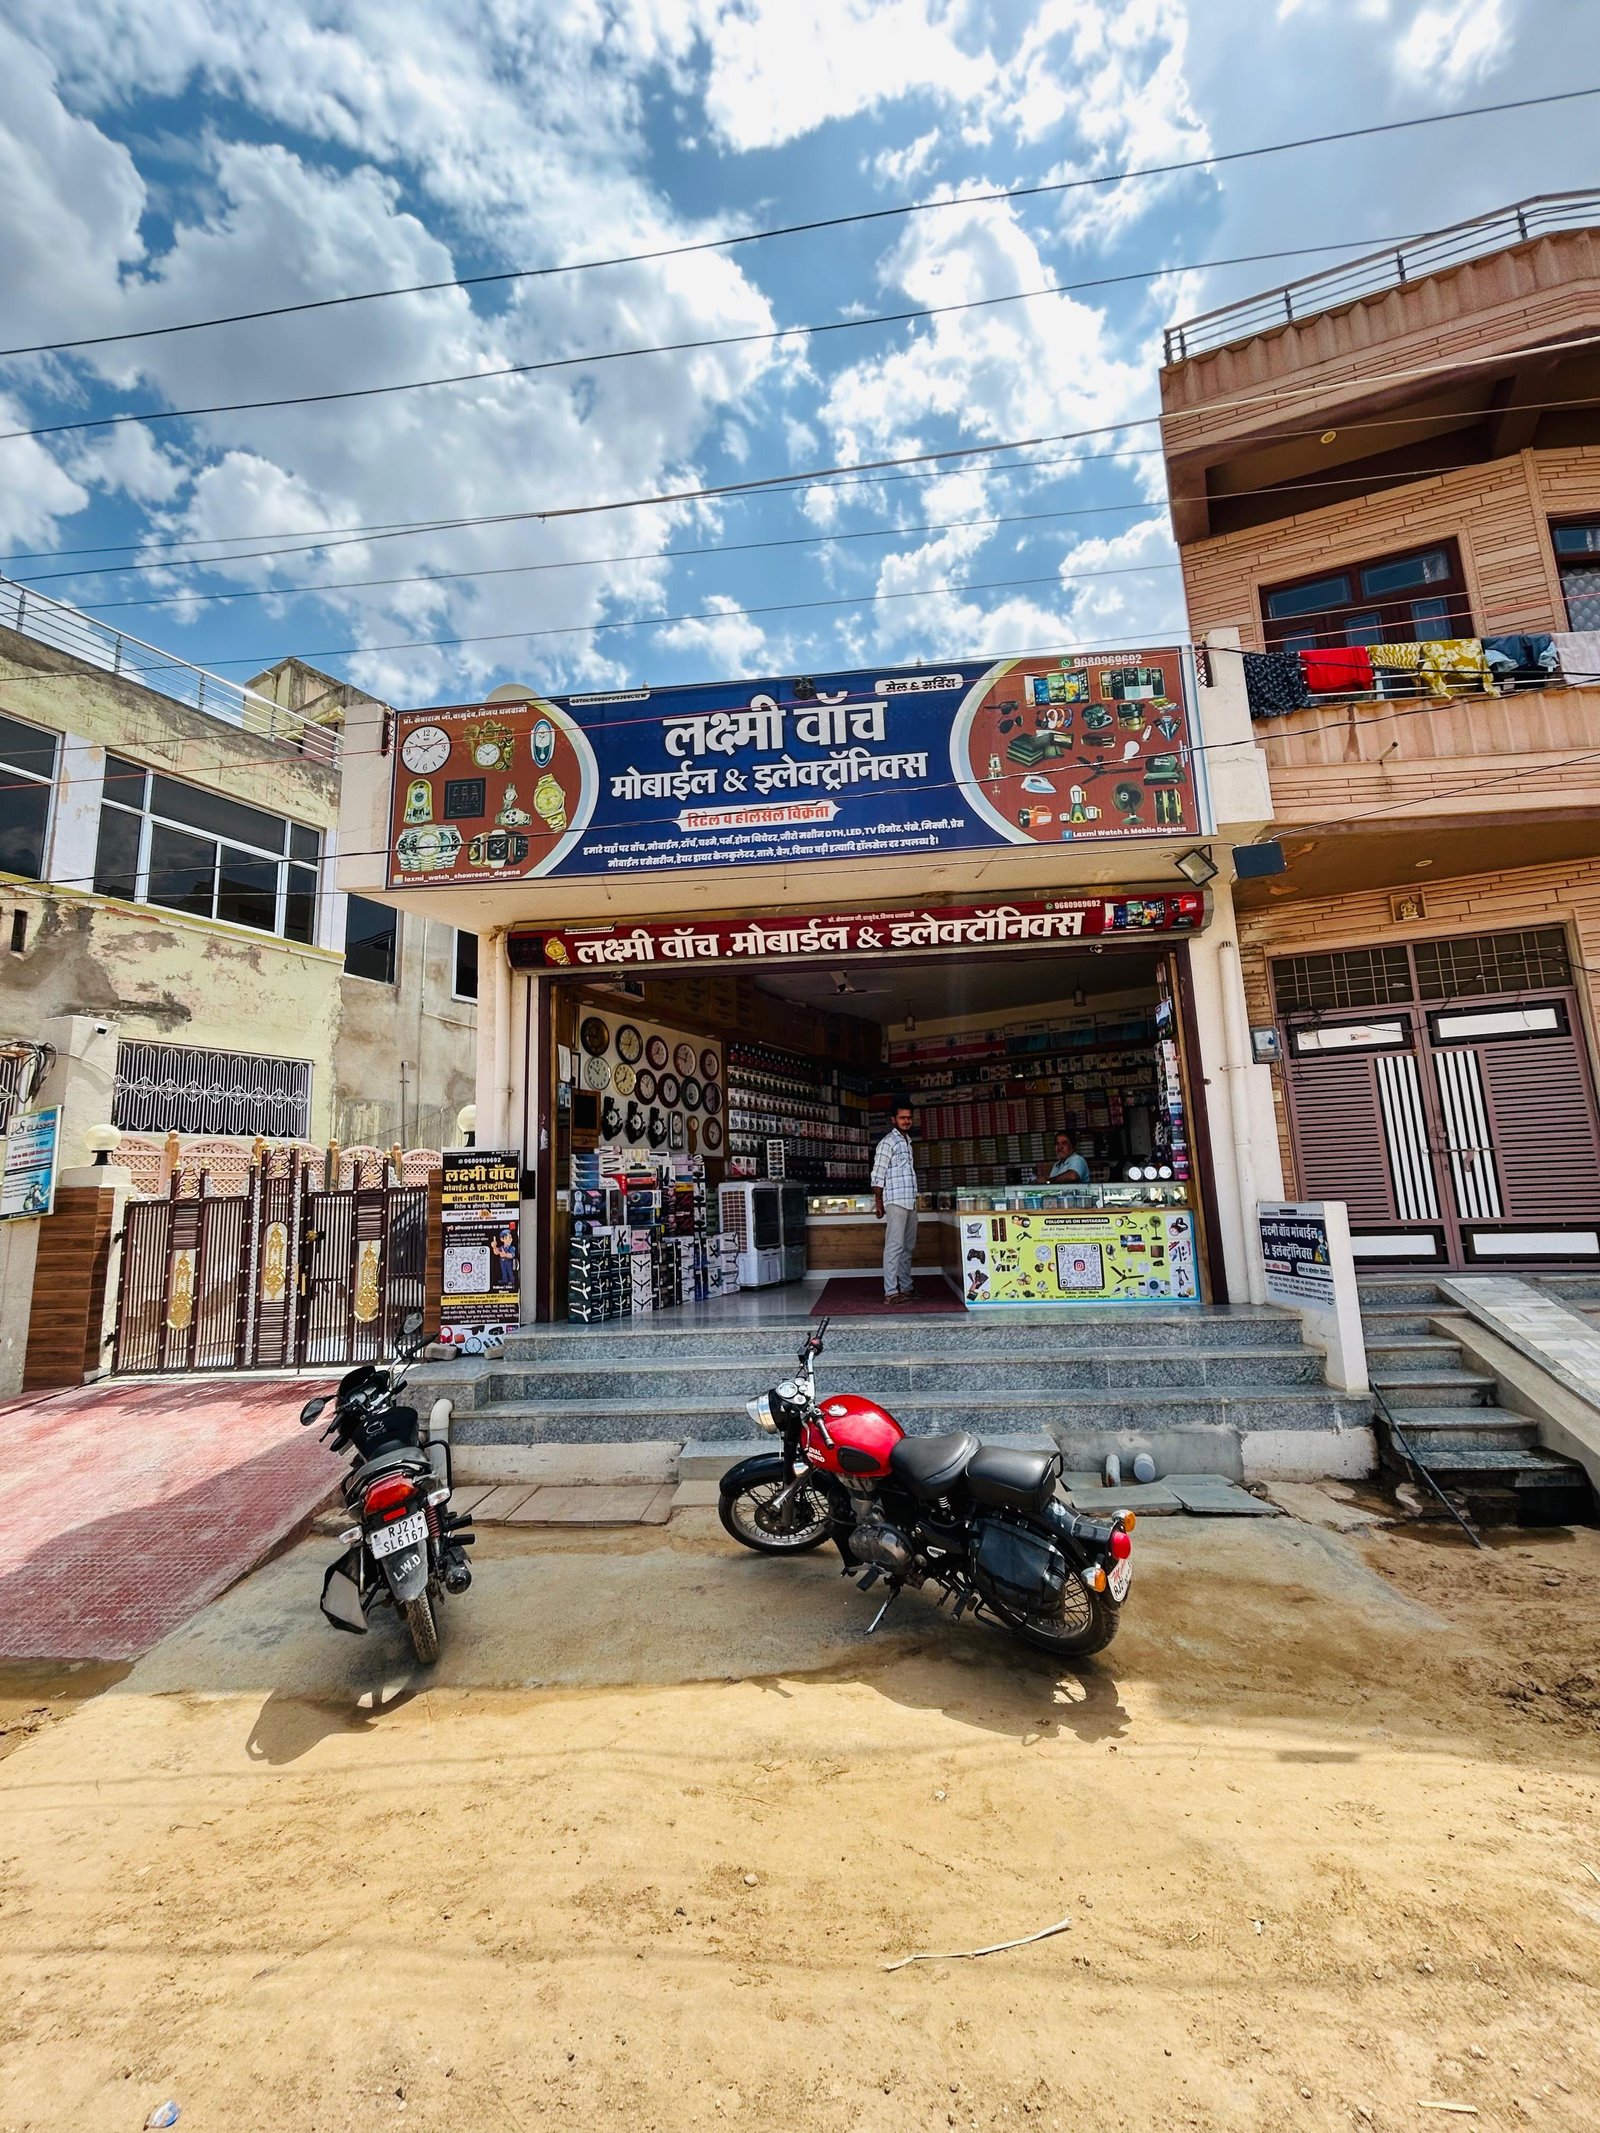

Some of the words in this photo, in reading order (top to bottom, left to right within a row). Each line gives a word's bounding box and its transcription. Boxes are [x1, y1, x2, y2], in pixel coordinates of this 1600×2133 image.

[1074, 654, 1142, 667] 9680969692
[911, 682, 919, 690] &
[662, 695, 786, 756] लक्ष्मी
[794, 691, 888, 745] वॉच
[611, 761, 717, 800] मोबाईल
[723, 769, 748, 792] &
[753, 747, 928, 794] इलेक्ट्रॉनिक्स
[1054, 900, 1100, 909] 9680969692
[574, 928, 655, 963] लक्ष्मी
[658, 928, 719, 958] वॉच
[856, 926, 884, 949] &
[445, 1165, 487, 1182] लक्ष्मी
[489, 1164, 516, 1180] वॉच
[470, 1183, 475, 1191] &
[1261, 1223, 1278, 1236] लक्ष्मी
[1291, 1224, 1317, 1240] मोबाईल
[388, 1520, 416, 1539] RJ21
[384, 1527, 424, 1552] SL6167
[393, 1554, 421, 1582] L.W.D
